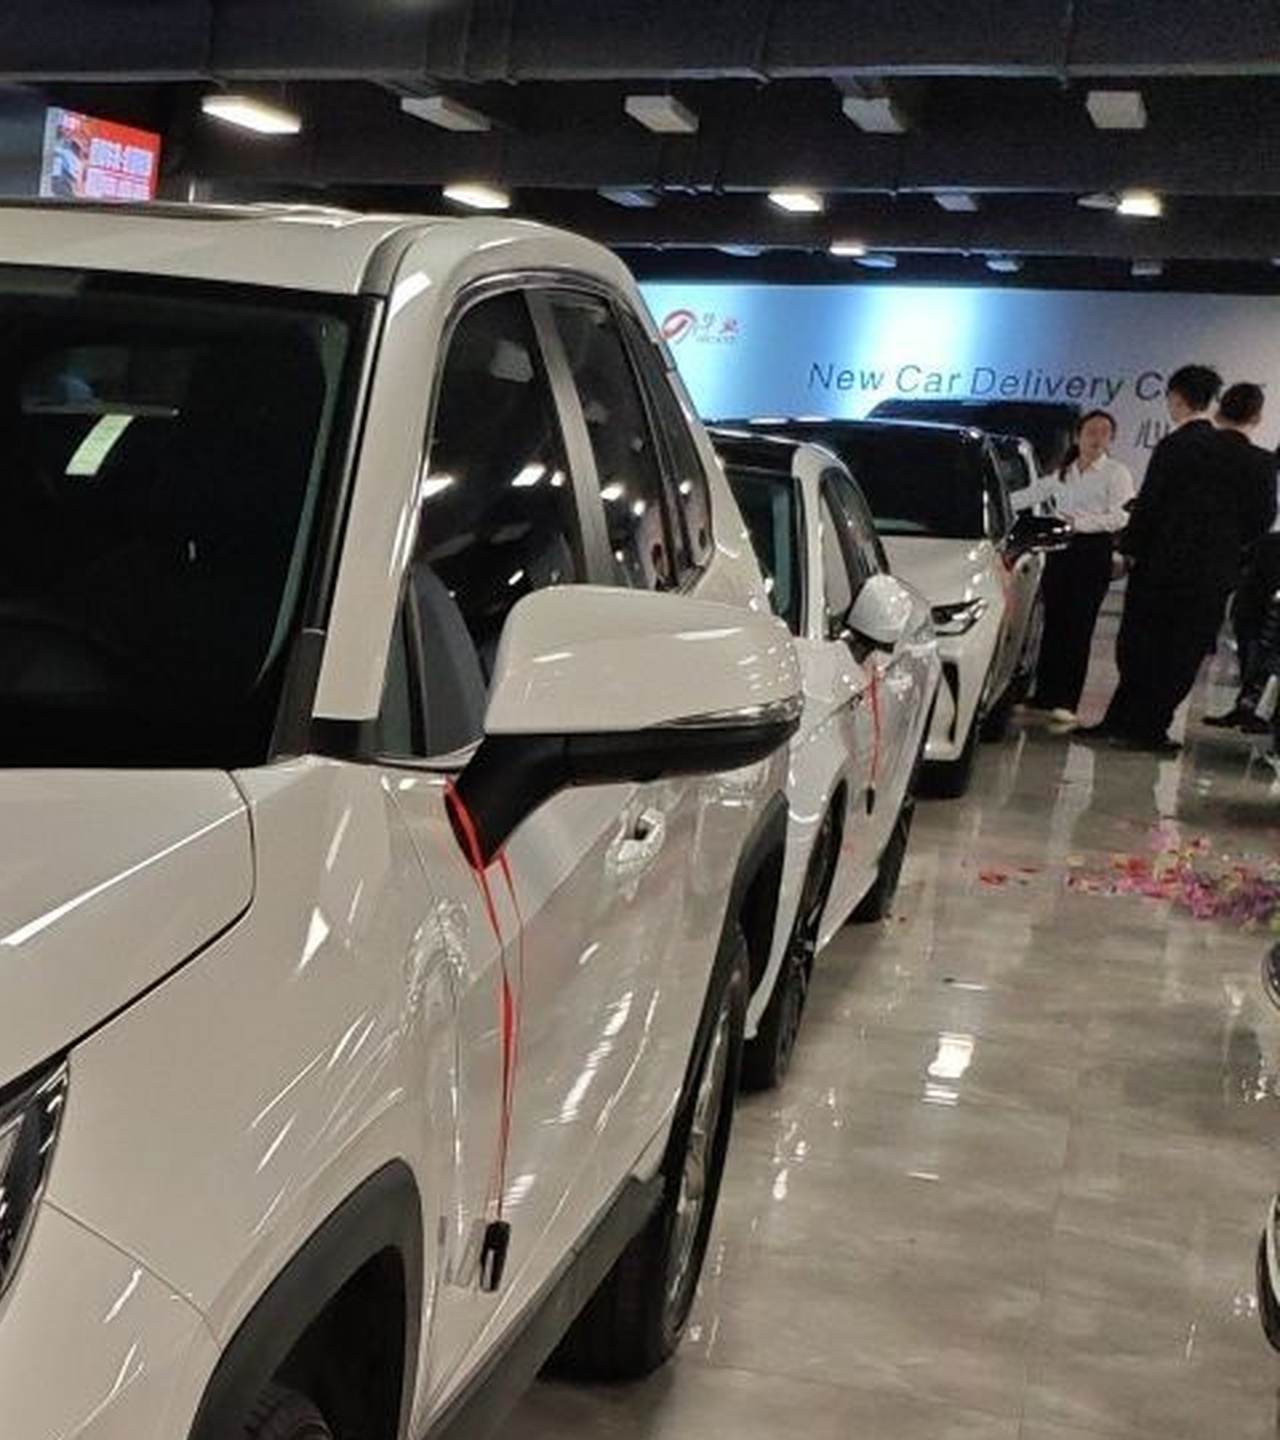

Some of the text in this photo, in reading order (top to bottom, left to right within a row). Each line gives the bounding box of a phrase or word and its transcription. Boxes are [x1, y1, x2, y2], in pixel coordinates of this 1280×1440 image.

[807, 362, 885, 391] New
[895, 364, 962, 394] Car
[970, 367, 1123, 406] Delivery
